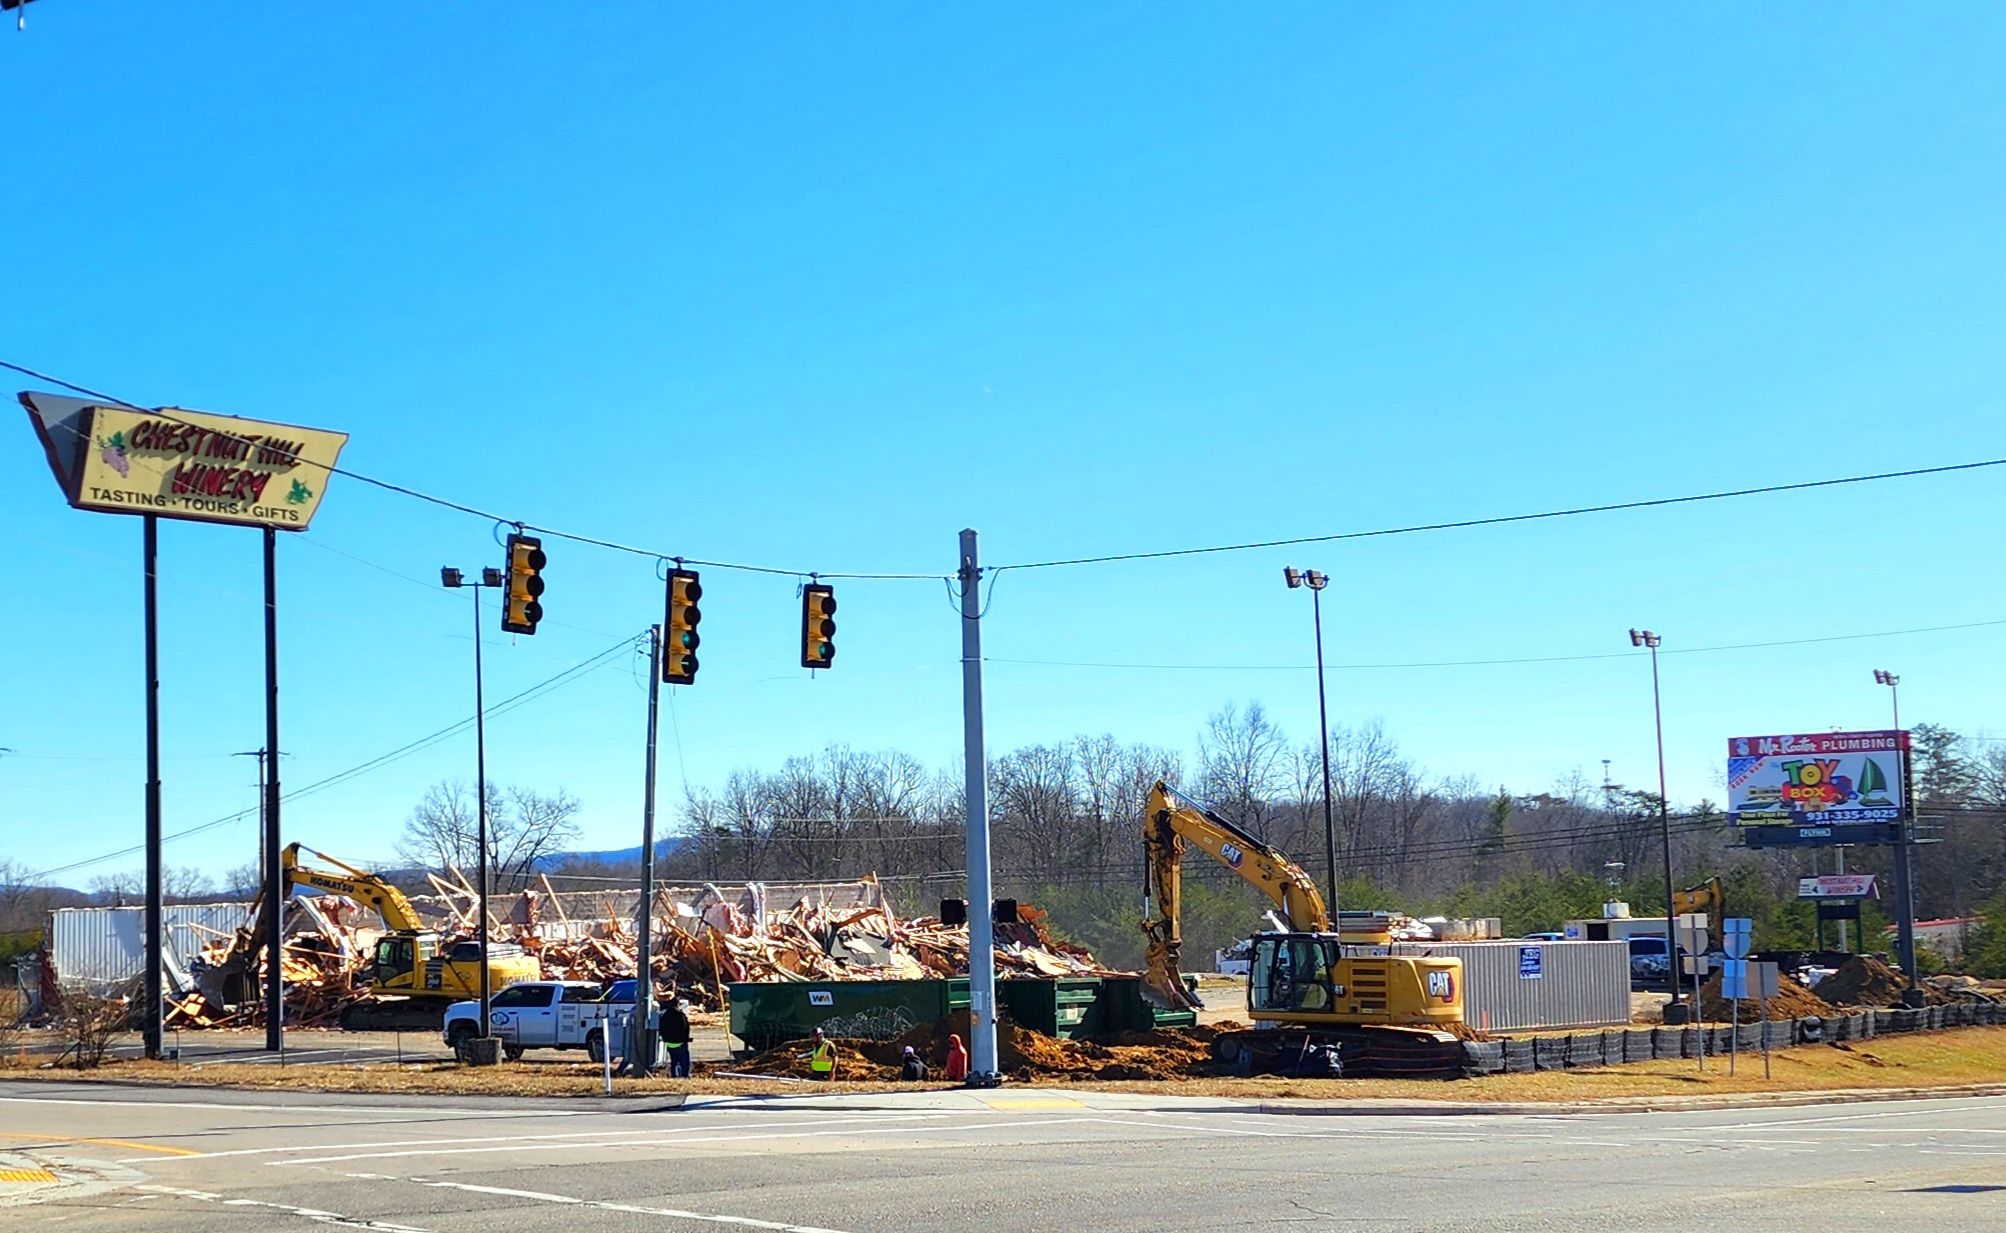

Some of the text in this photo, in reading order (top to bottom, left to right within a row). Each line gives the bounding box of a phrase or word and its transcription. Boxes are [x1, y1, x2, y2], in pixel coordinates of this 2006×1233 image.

[130, 420, 306, 468] CHESTNUT HILL
[171, 462, 273, 503] WINERY
[89, 487, 299, 521] TASTING TOURS GIFTS
[1821, 738, 1896, 750] PLUMBING
[1781, 758, 1841, 786] TOY
[1789, 787, 1826, 798] BOX
[1805, 810, 1899, 821] 931-335-9025
[1220, 843, 1242, 861] CAT
[310, 876, 354, 893] KOMATSU
[1429, 972, 1450, 996] CAT
[812, 994, 830, 1003] WM
